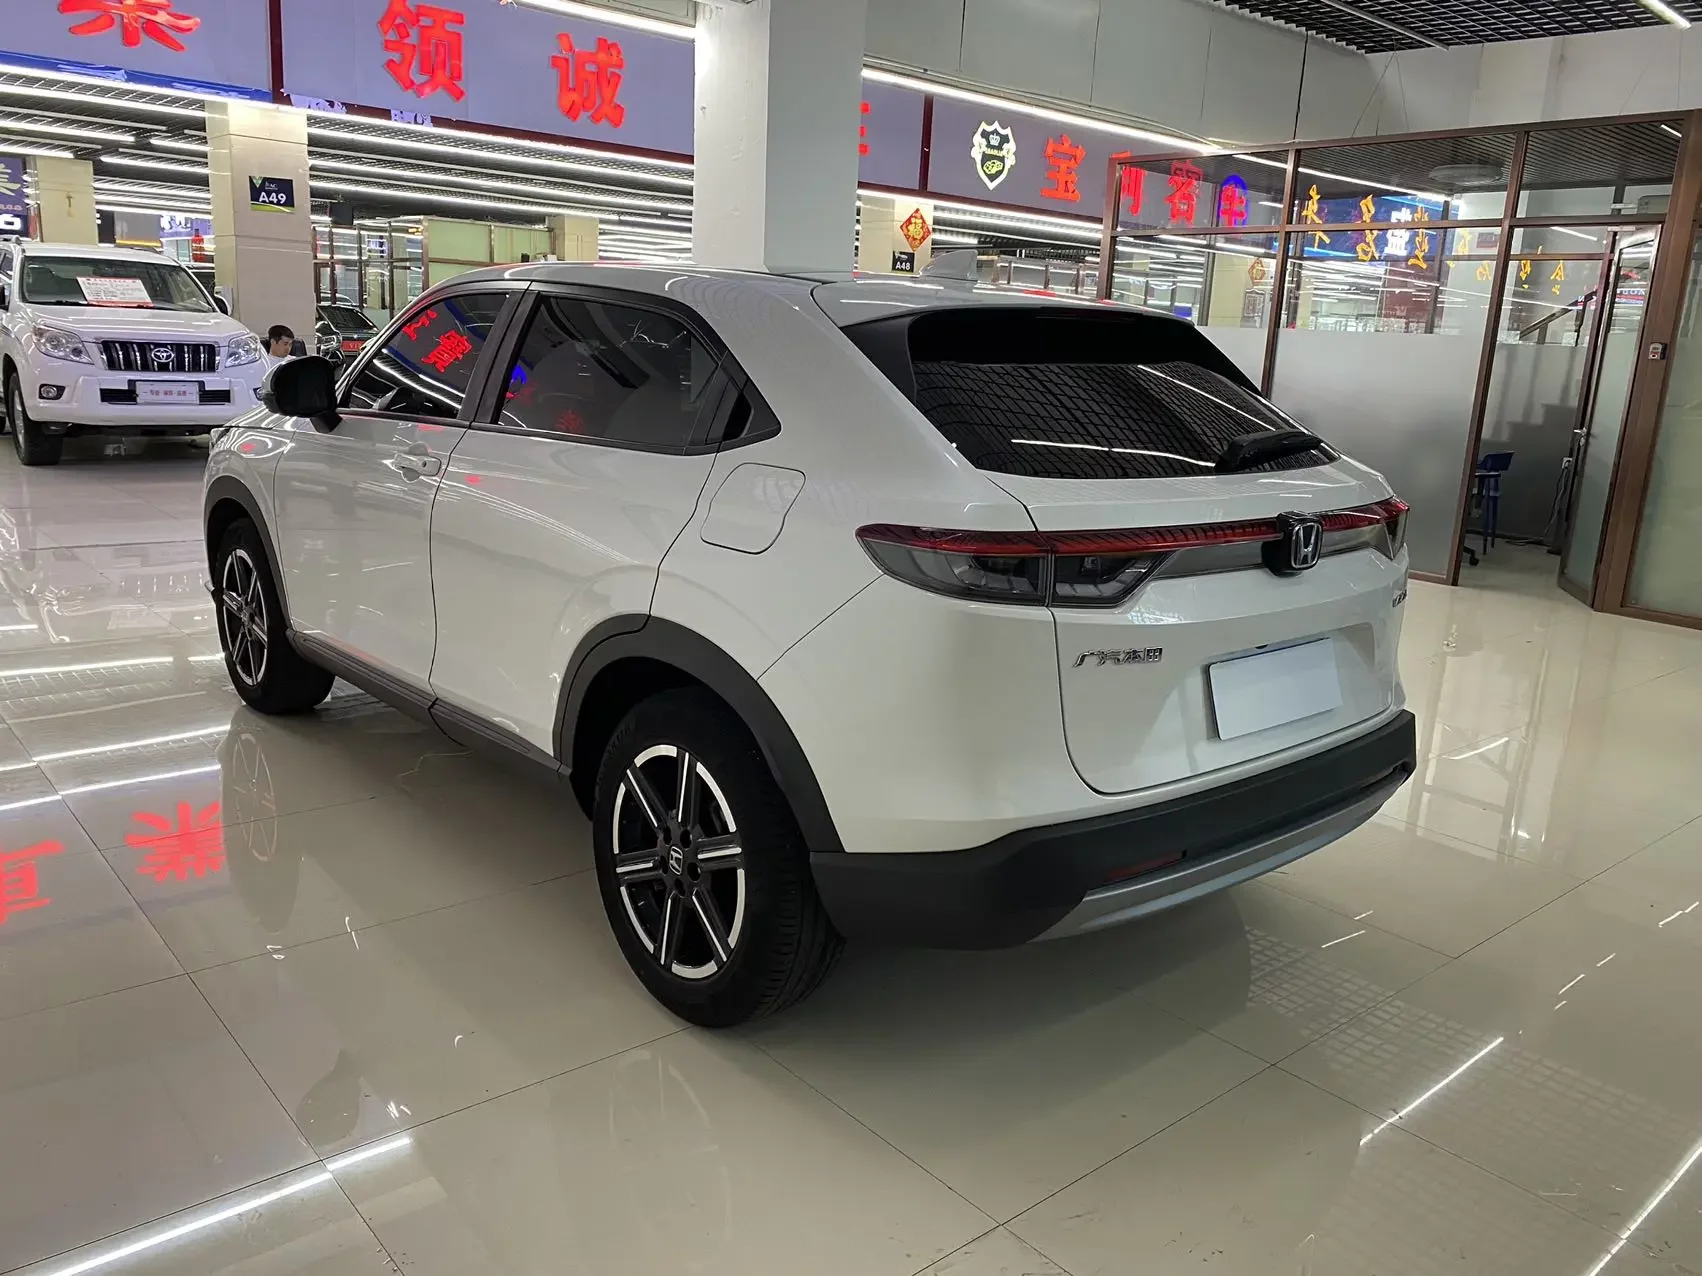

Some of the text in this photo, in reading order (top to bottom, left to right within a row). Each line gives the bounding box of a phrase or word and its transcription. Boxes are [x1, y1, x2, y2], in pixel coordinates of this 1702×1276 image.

[258, 191, 287, 204] A49
[895, 261, 911, 271] A48
[1073, 646, 1163, 668] 广汽本田
